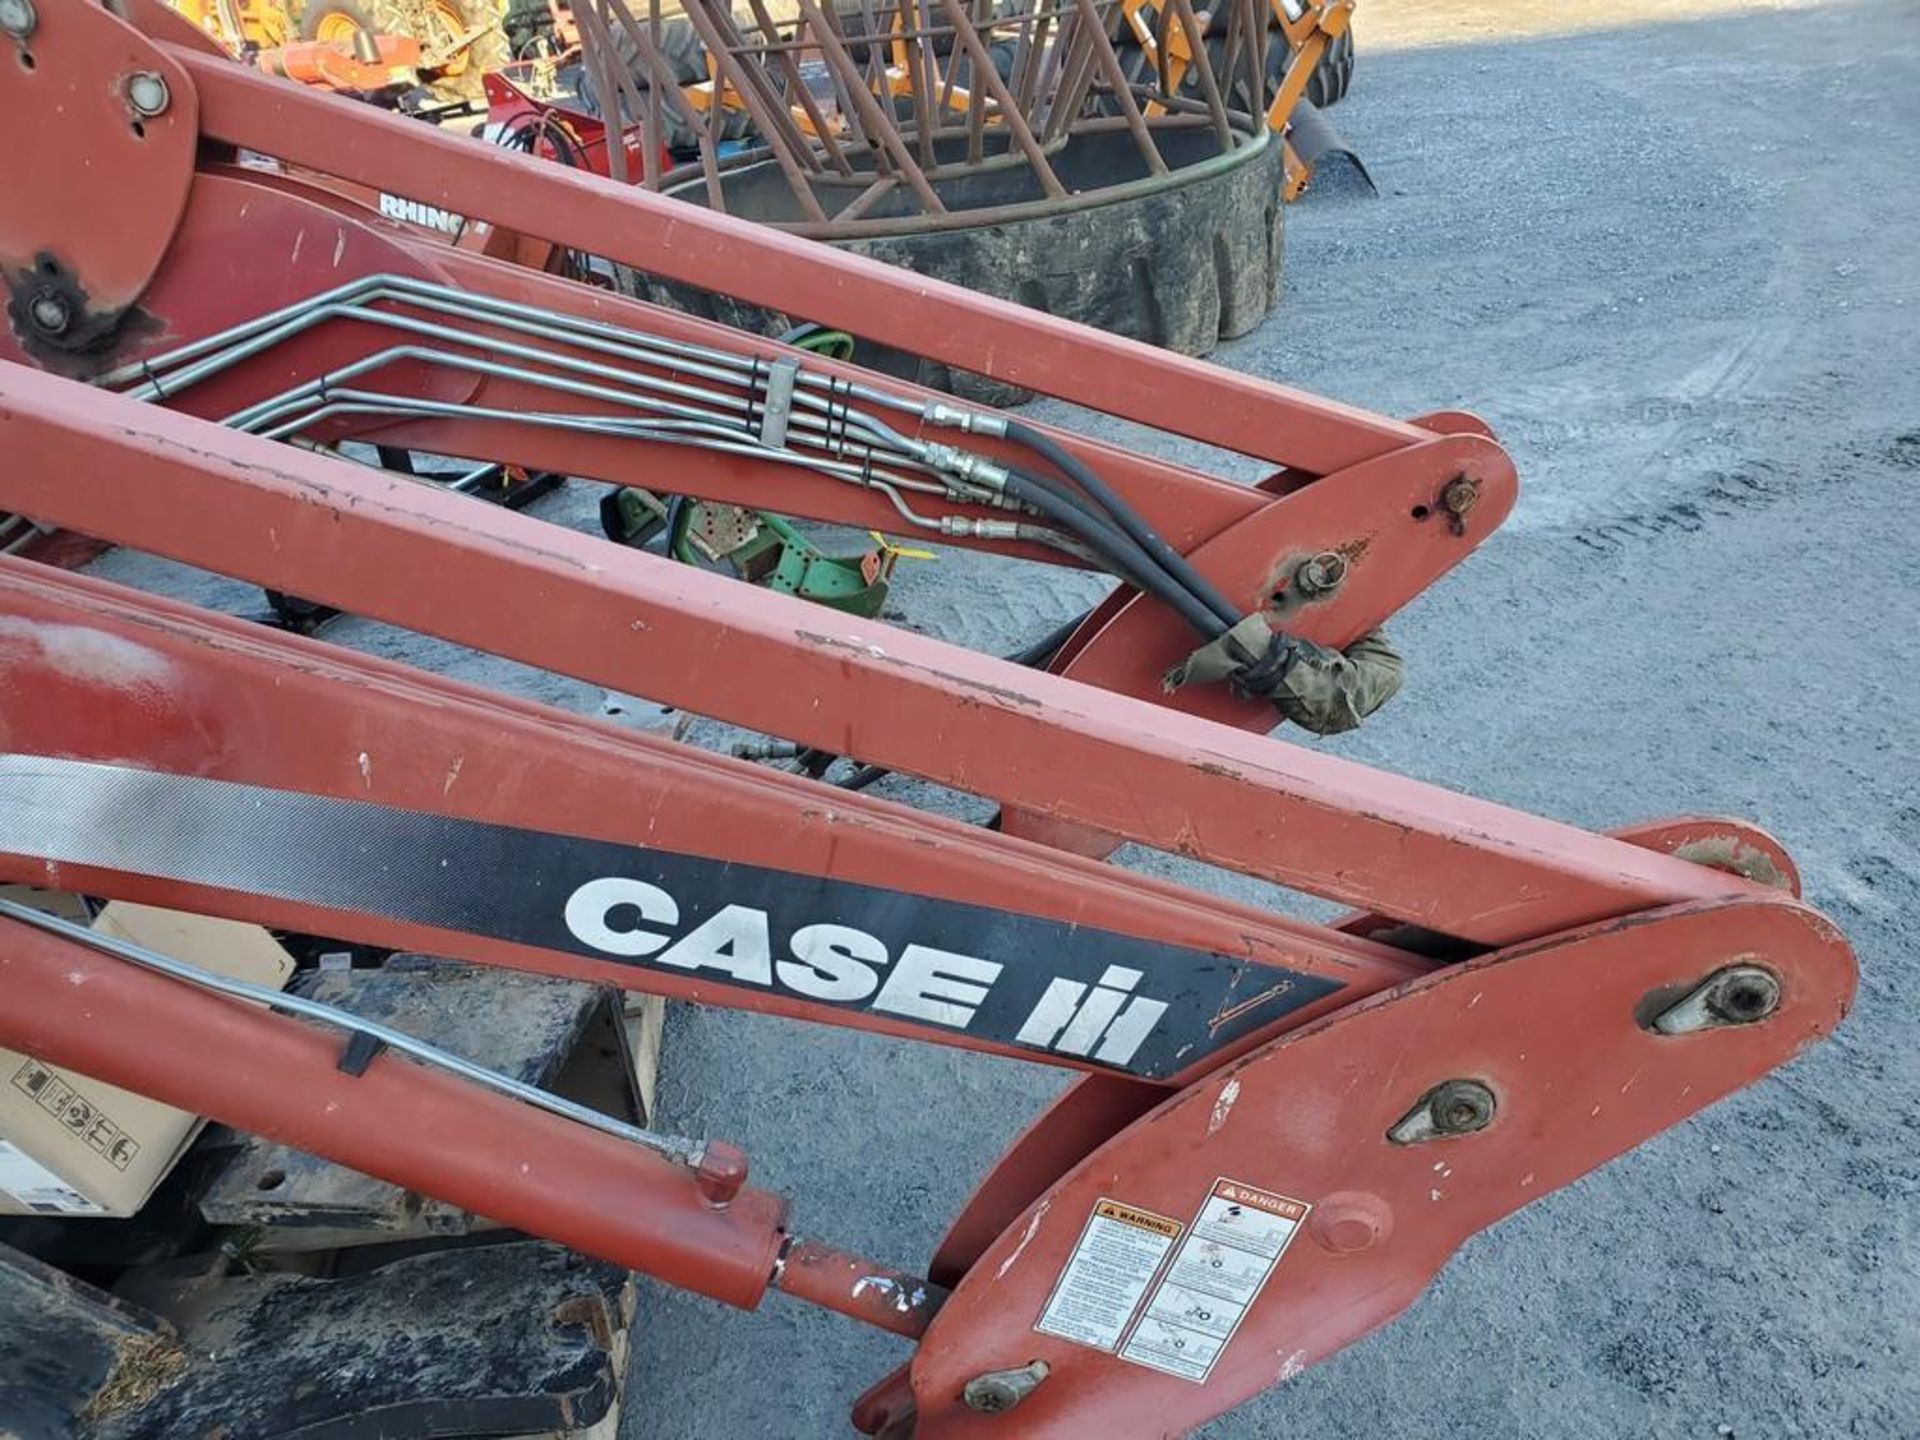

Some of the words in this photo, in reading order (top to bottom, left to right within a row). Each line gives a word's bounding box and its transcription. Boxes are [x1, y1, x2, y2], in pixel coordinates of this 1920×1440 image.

[564, 877, 1004, 1028] CASE
[1239, 1191, 1297, 1215] DANGER
[1119, 1211, 1173, 1235] WARNING
